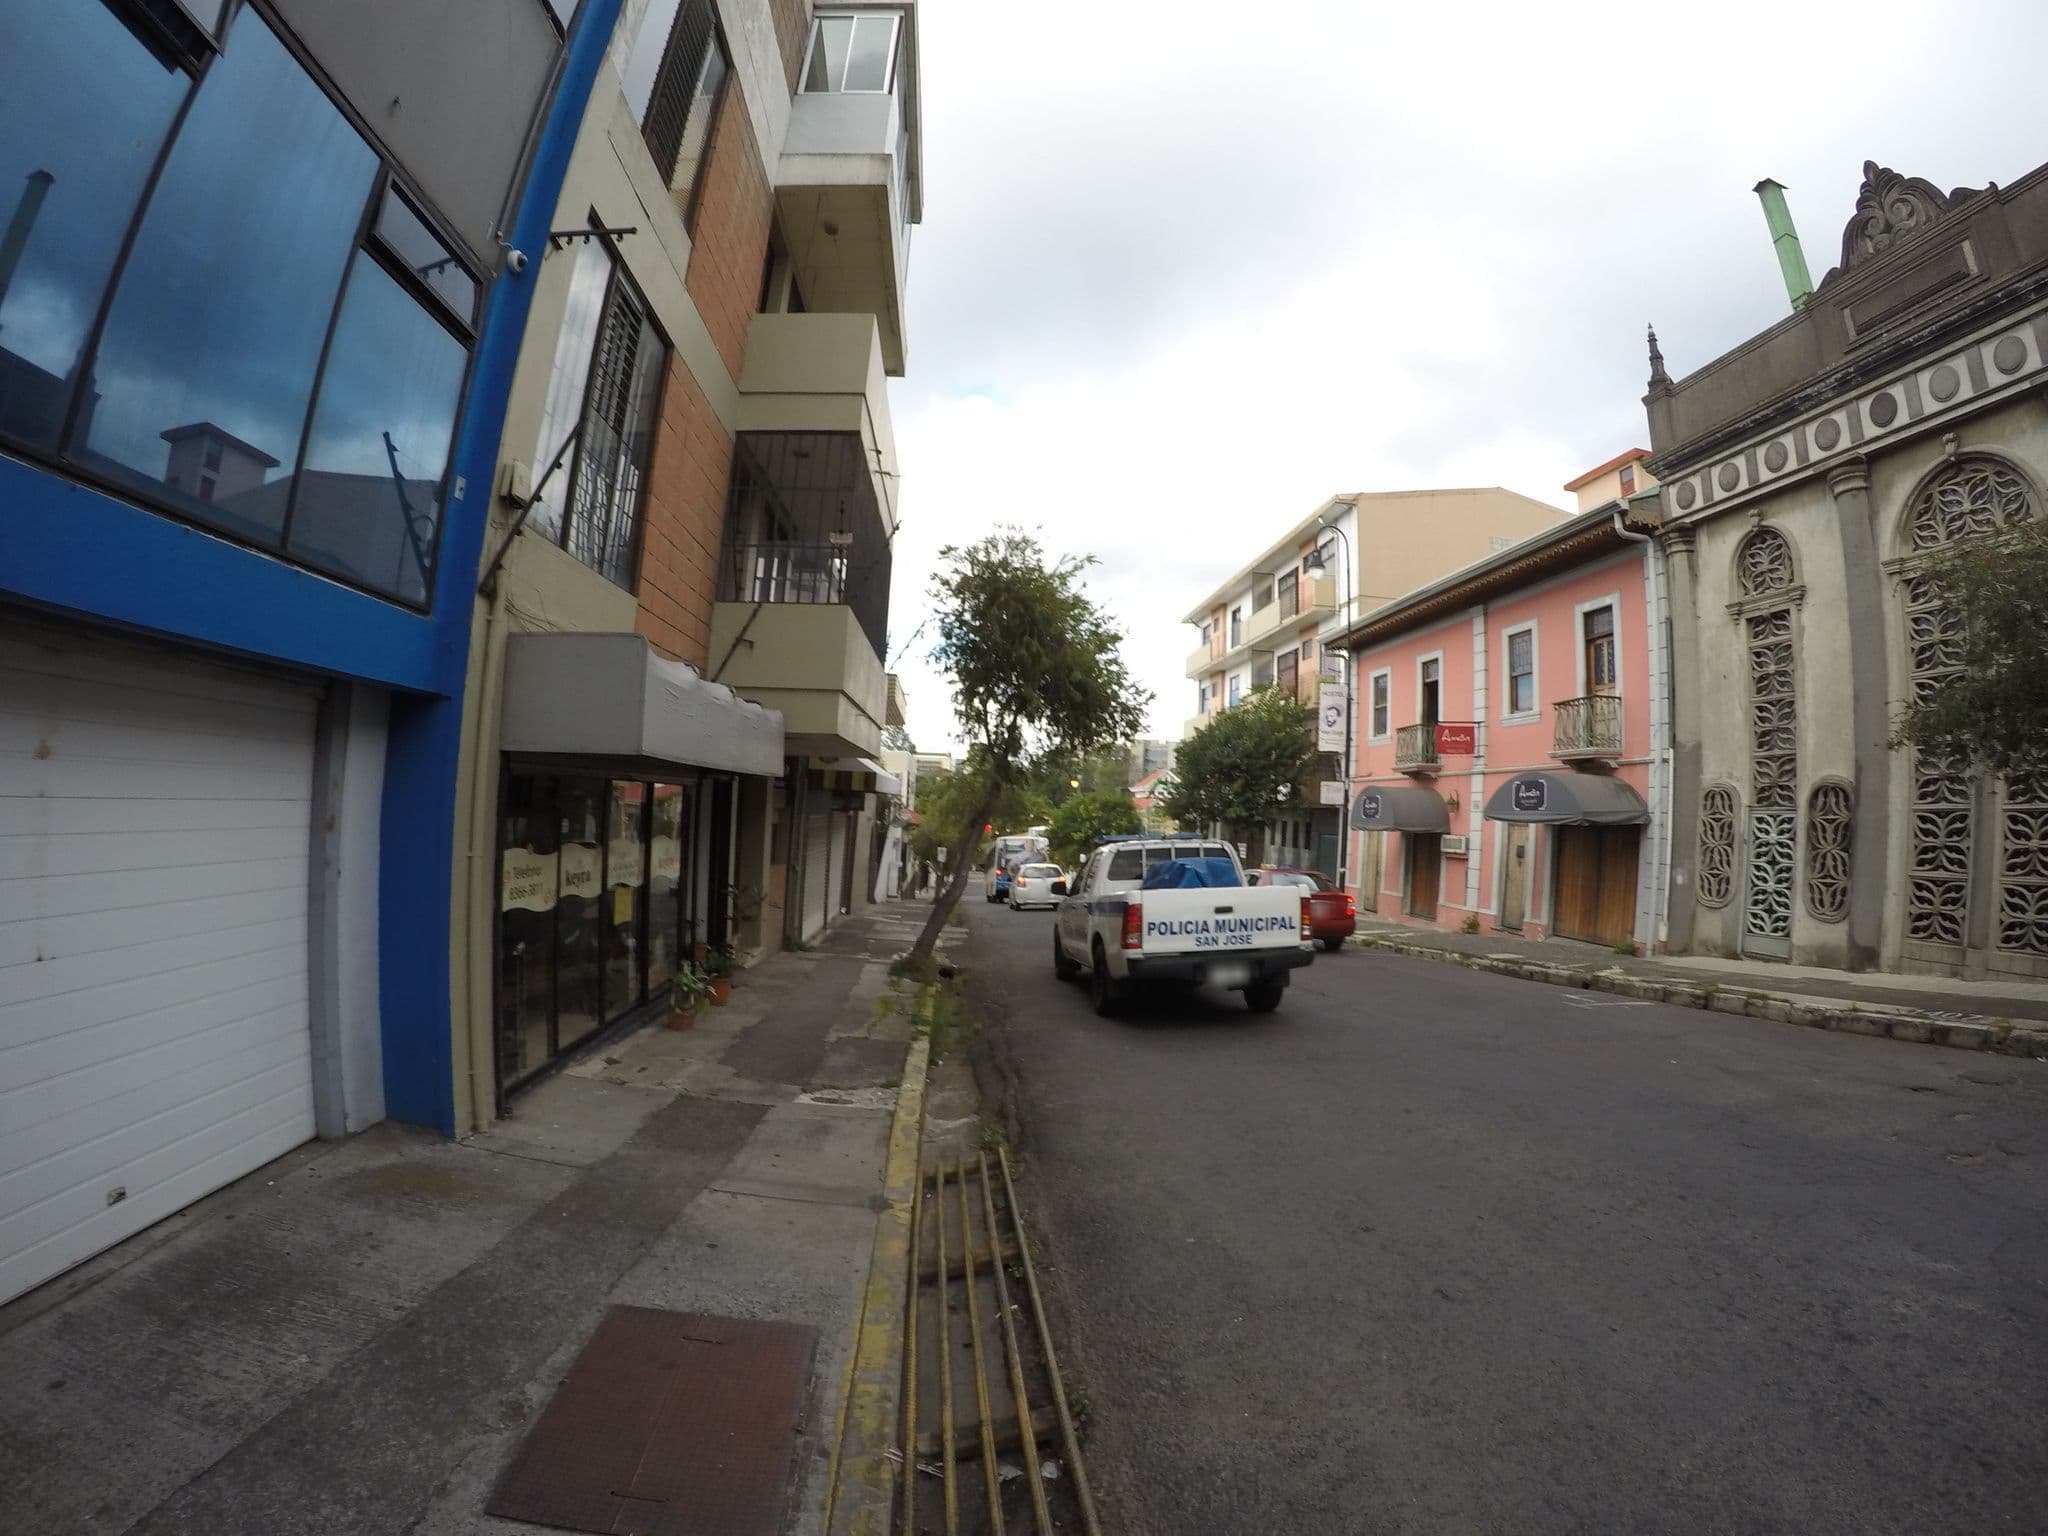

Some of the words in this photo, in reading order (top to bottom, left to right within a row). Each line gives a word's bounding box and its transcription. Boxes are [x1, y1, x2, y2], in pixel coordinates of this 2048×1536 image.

[1147, 920, 1210, 936] POLICIA
[1215, 917, 1296, 933] MUNICIPAL
[1195, 936, 1219, 946] SAN
[1223, 935, 1253, 945] JOSE
